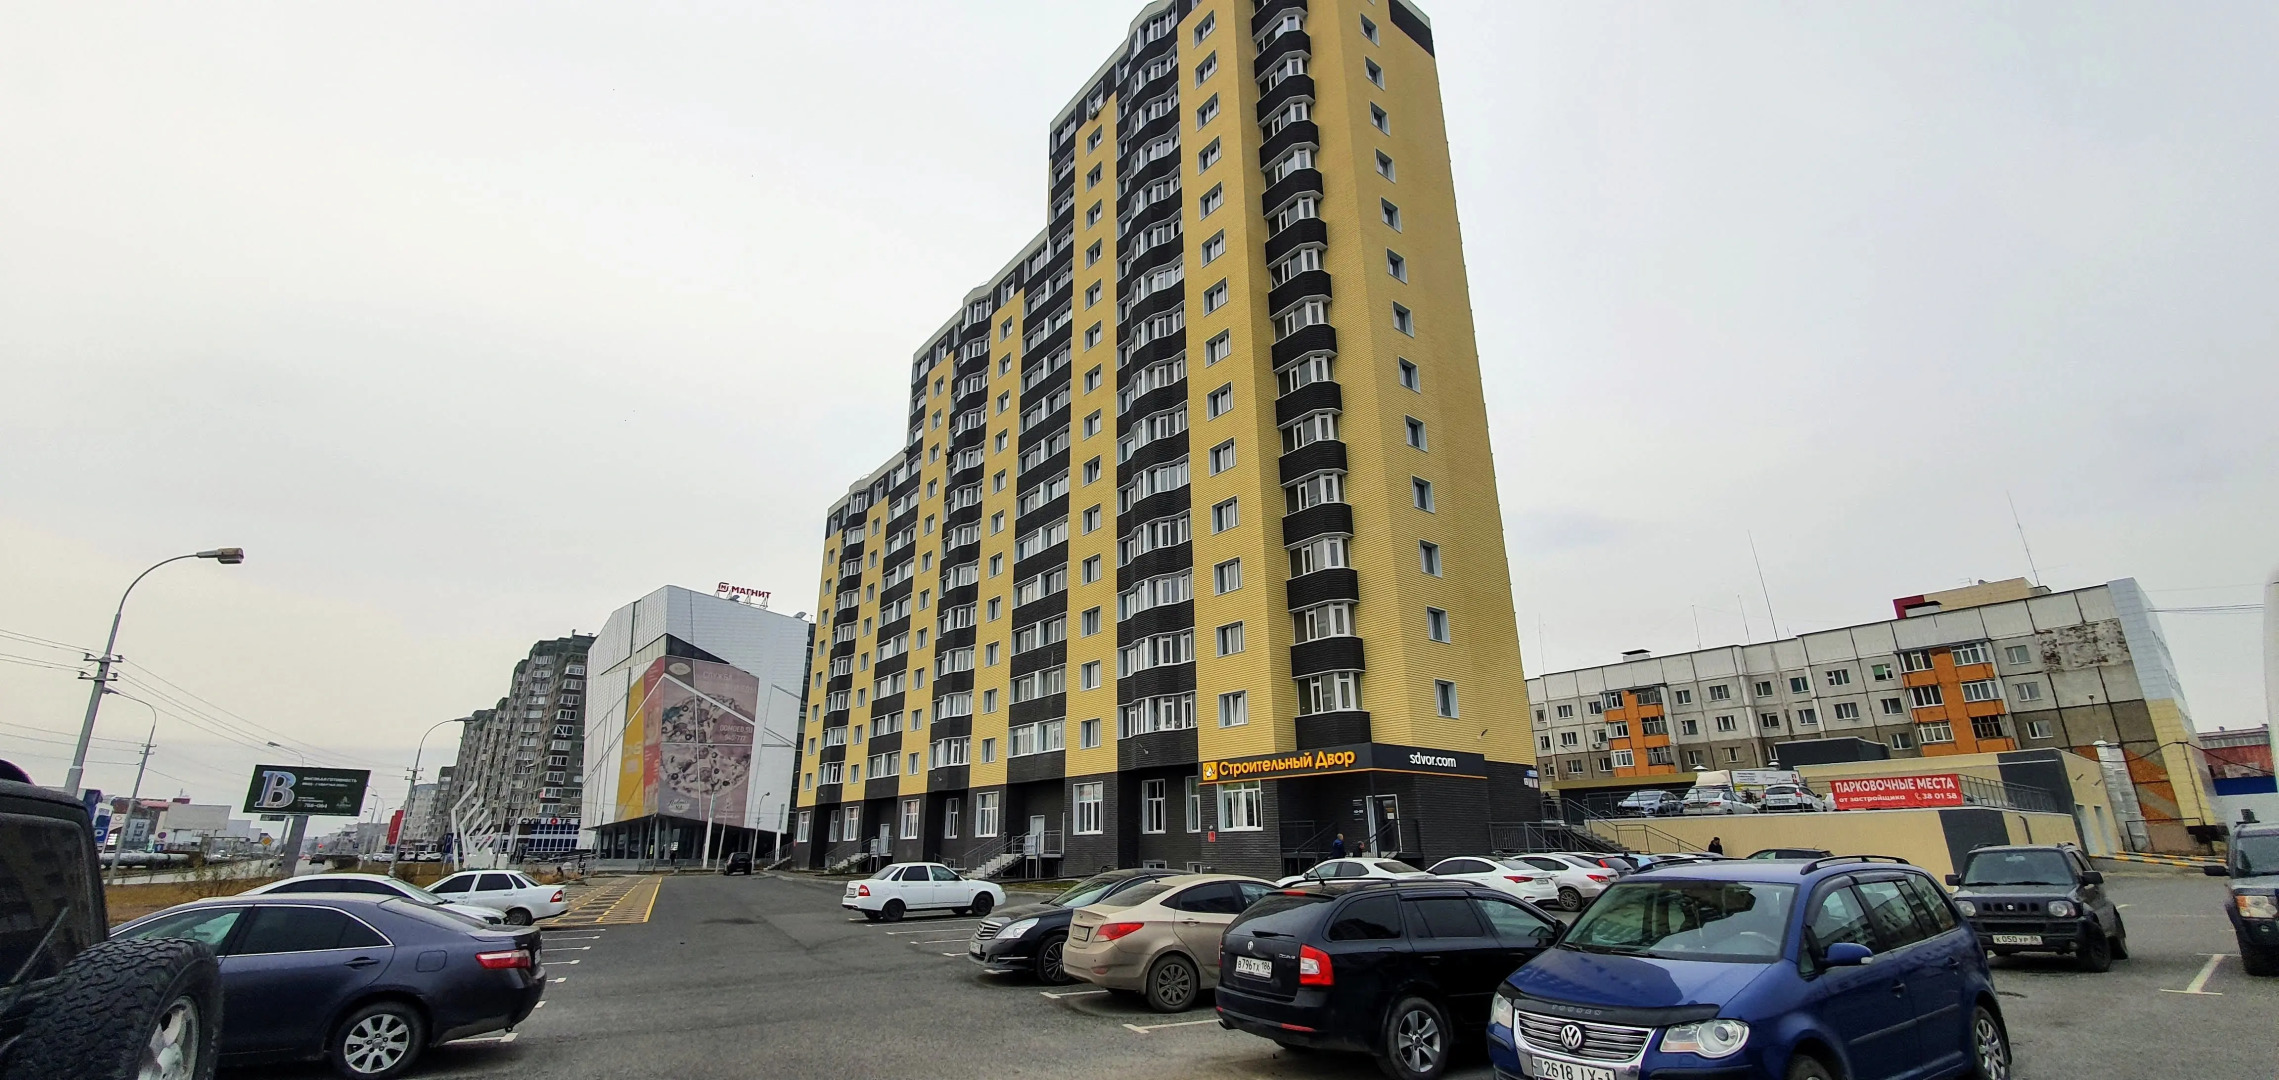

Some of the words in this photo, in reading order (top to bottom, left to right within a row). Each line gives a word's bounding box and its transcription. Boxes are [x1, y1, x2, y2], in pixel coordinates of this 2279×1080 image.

[731, 586, 771, 598] МАГНИТ
[1219, 752, 1313, 777] Строительный
[1315, 750, 1356, 769] Двор
[1409, 751, 1457, 768] sdvor.com
[1835, 778, 1916, 793] ПАРКОВОЧНЫЕ
[1916, 777, 1955, 790] МЕСТА
[1850, 794, 1906, 803] застройщика
[1543, 1060, 1574, 1080] 2618
